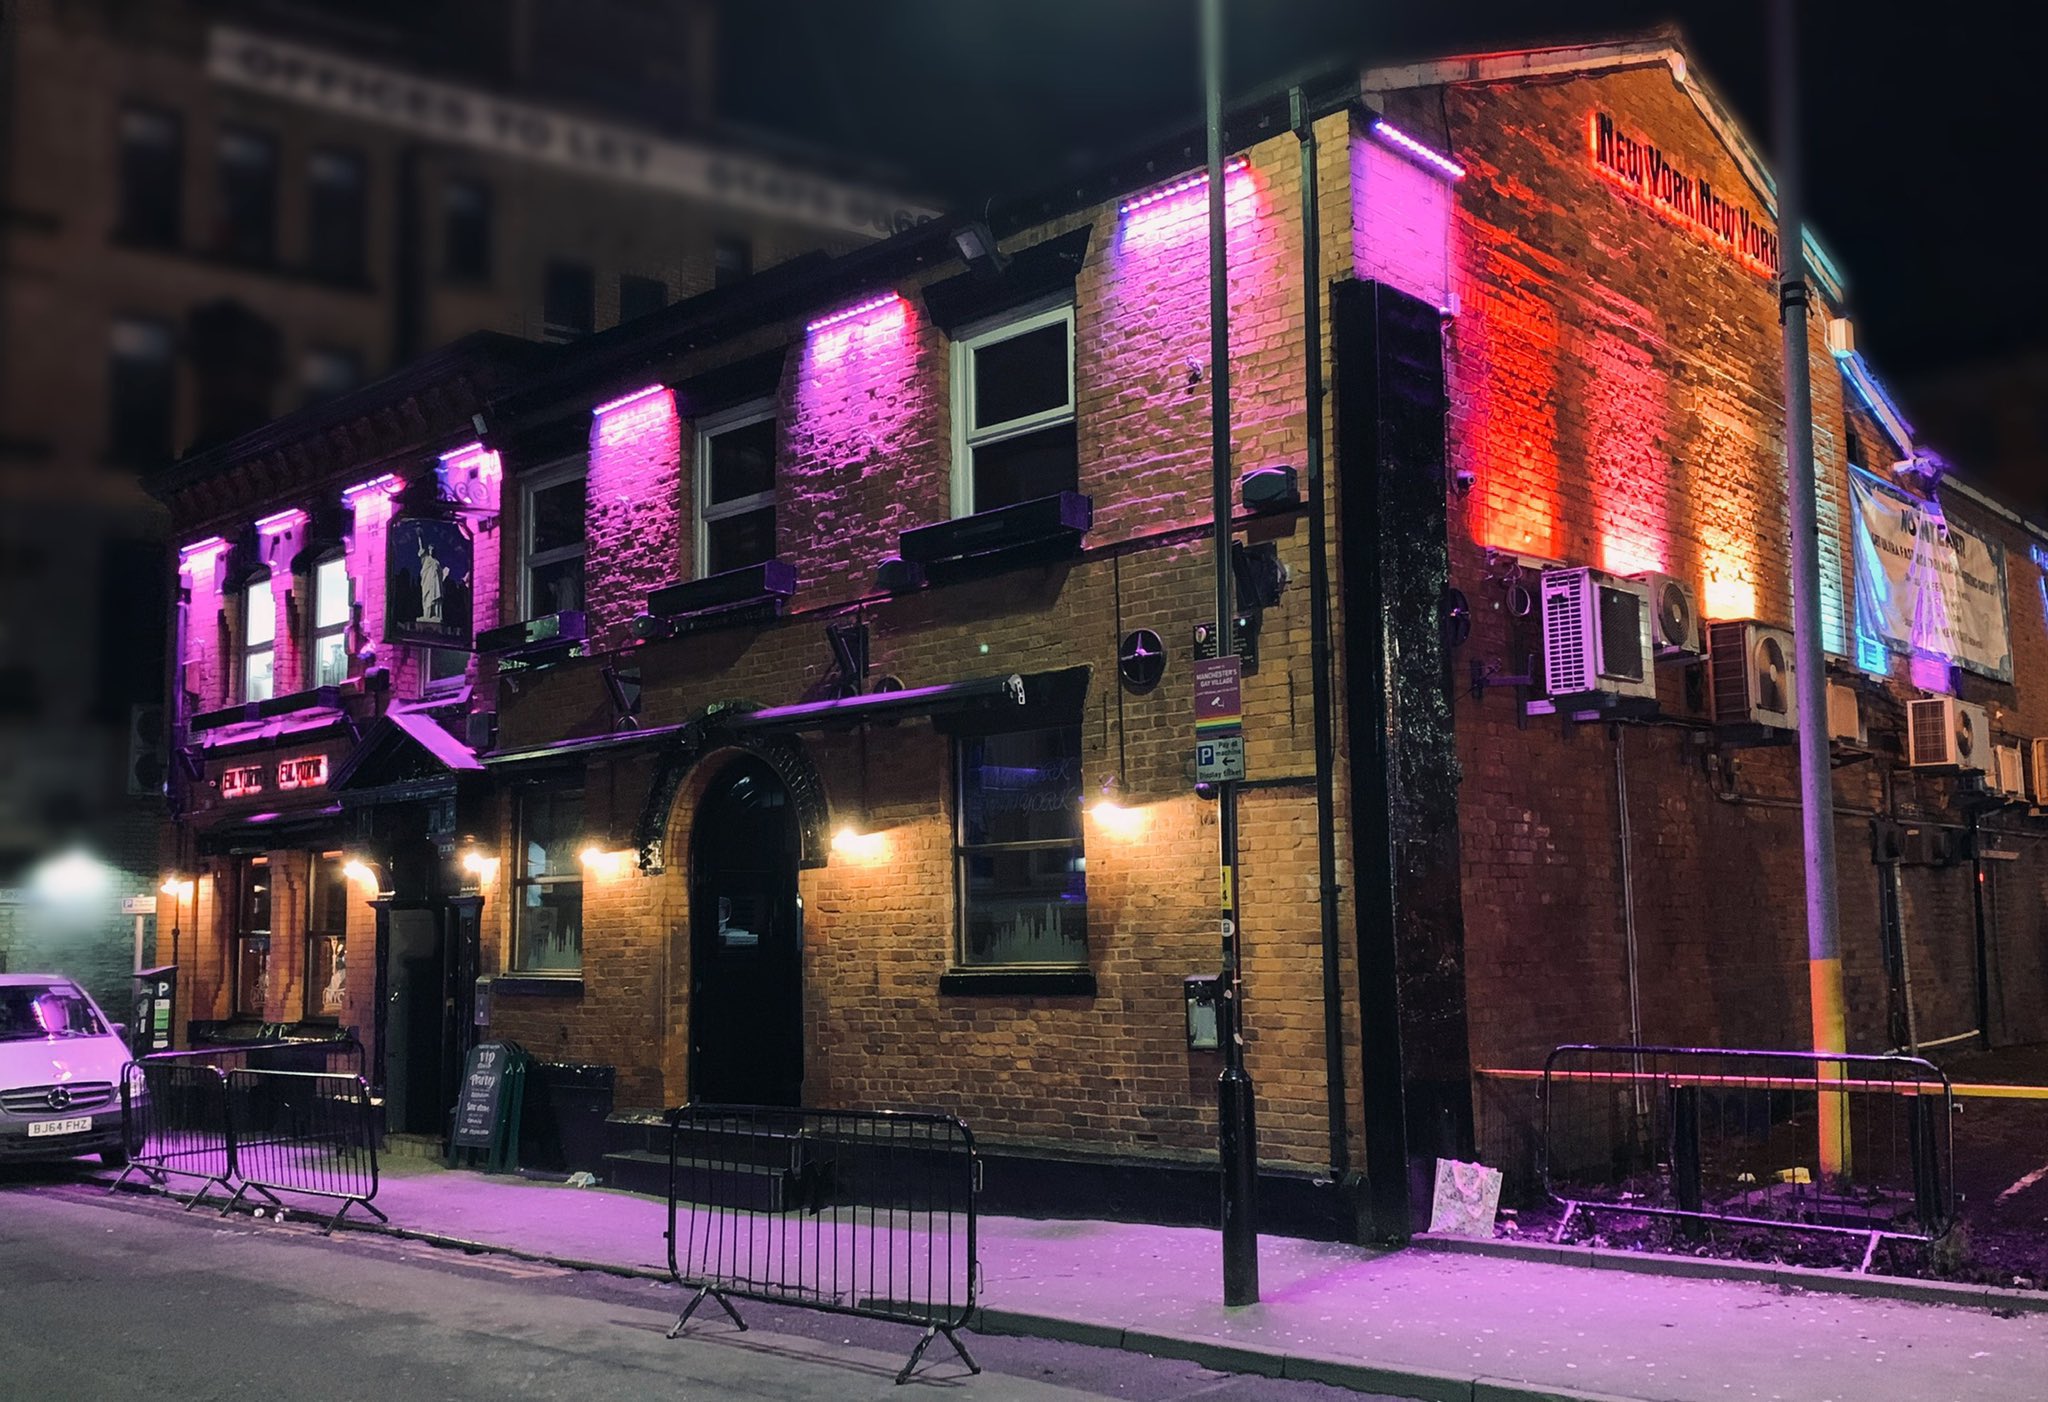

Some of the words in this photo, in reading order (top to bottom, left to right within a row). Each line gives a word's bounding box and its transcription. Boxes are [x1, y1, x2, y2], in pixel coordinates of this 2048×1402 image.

[494, 108, 553, 152] TO
[569, 131, 652, 173] LET
[1647, 144, 1695, 220] YORK
[1202, 747, 1211, 764] P
[158, 982, 169, 997] P
[33, 1122, 62, 1134] BJ64
[66, 1119, 87, 1131] FHZ
